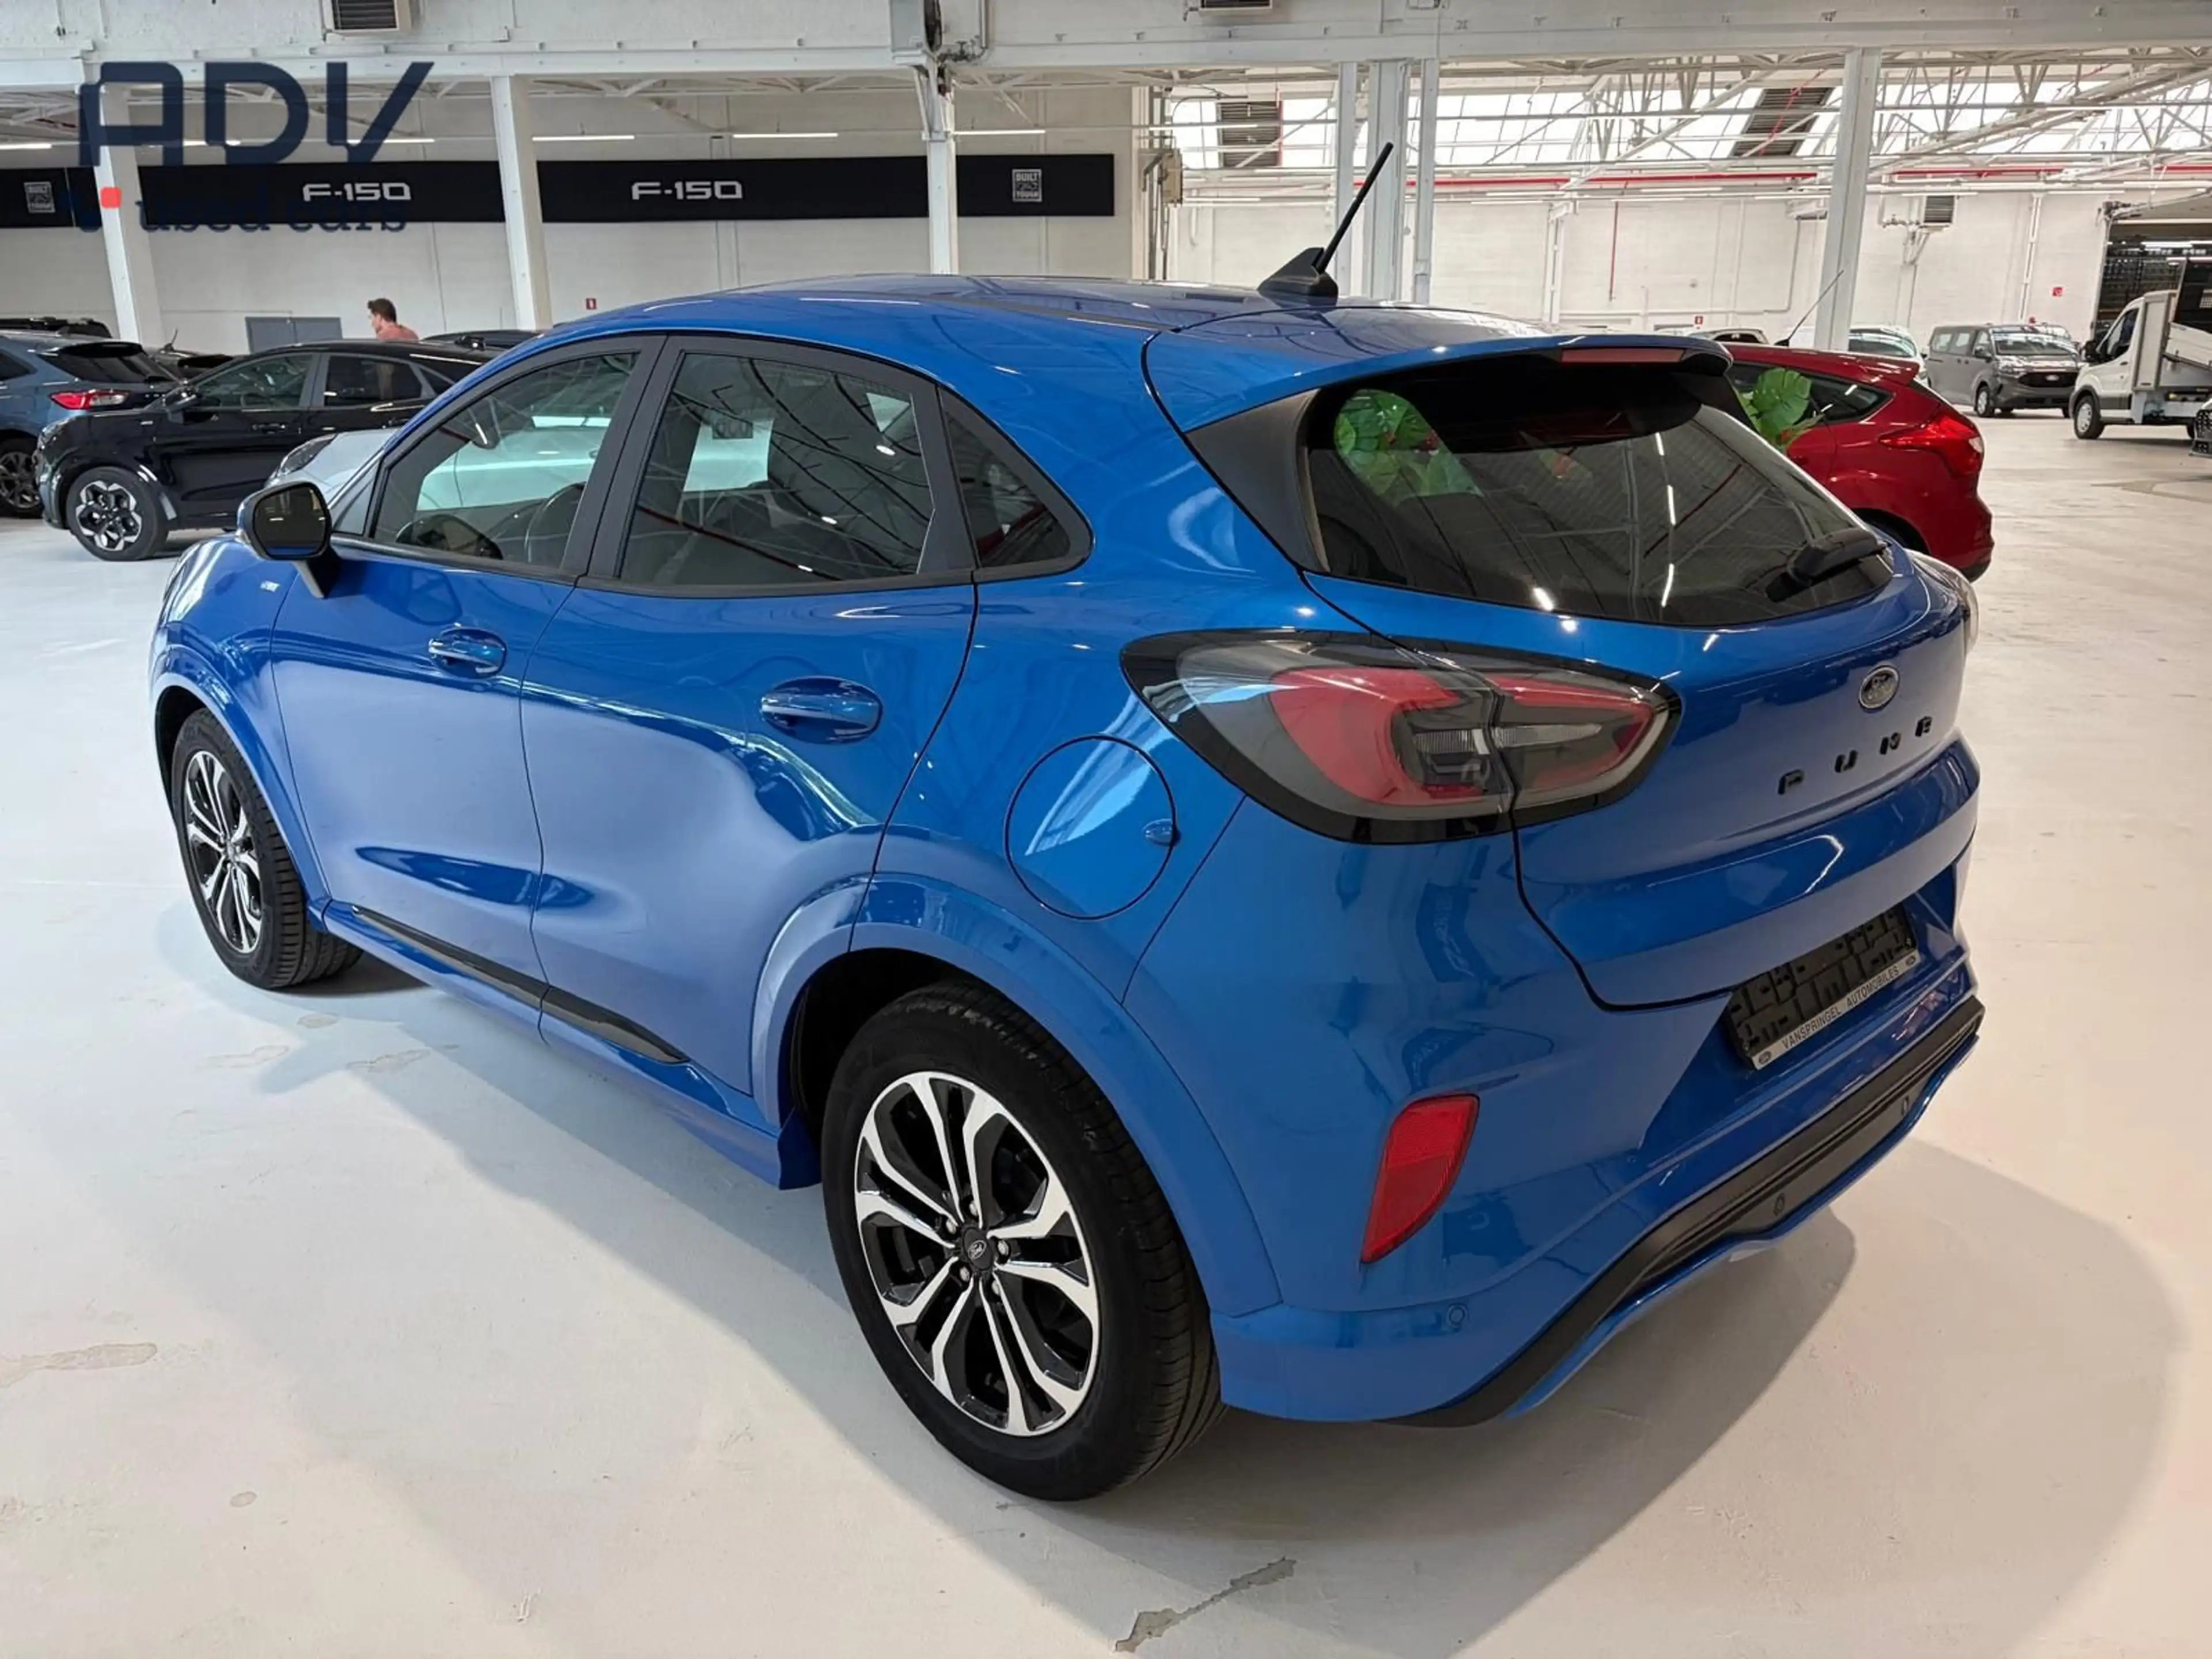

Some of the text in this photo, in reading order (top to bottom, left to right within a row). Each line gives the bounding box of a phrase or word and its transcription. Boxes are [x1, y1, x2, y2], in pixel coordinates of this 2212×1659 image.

[302, 183, 411, 201] F-150
[631, 181, 743, 200] F-150
[1782, 965, 1900, 1048] VANSPRINGEL AUTOMOBILES
